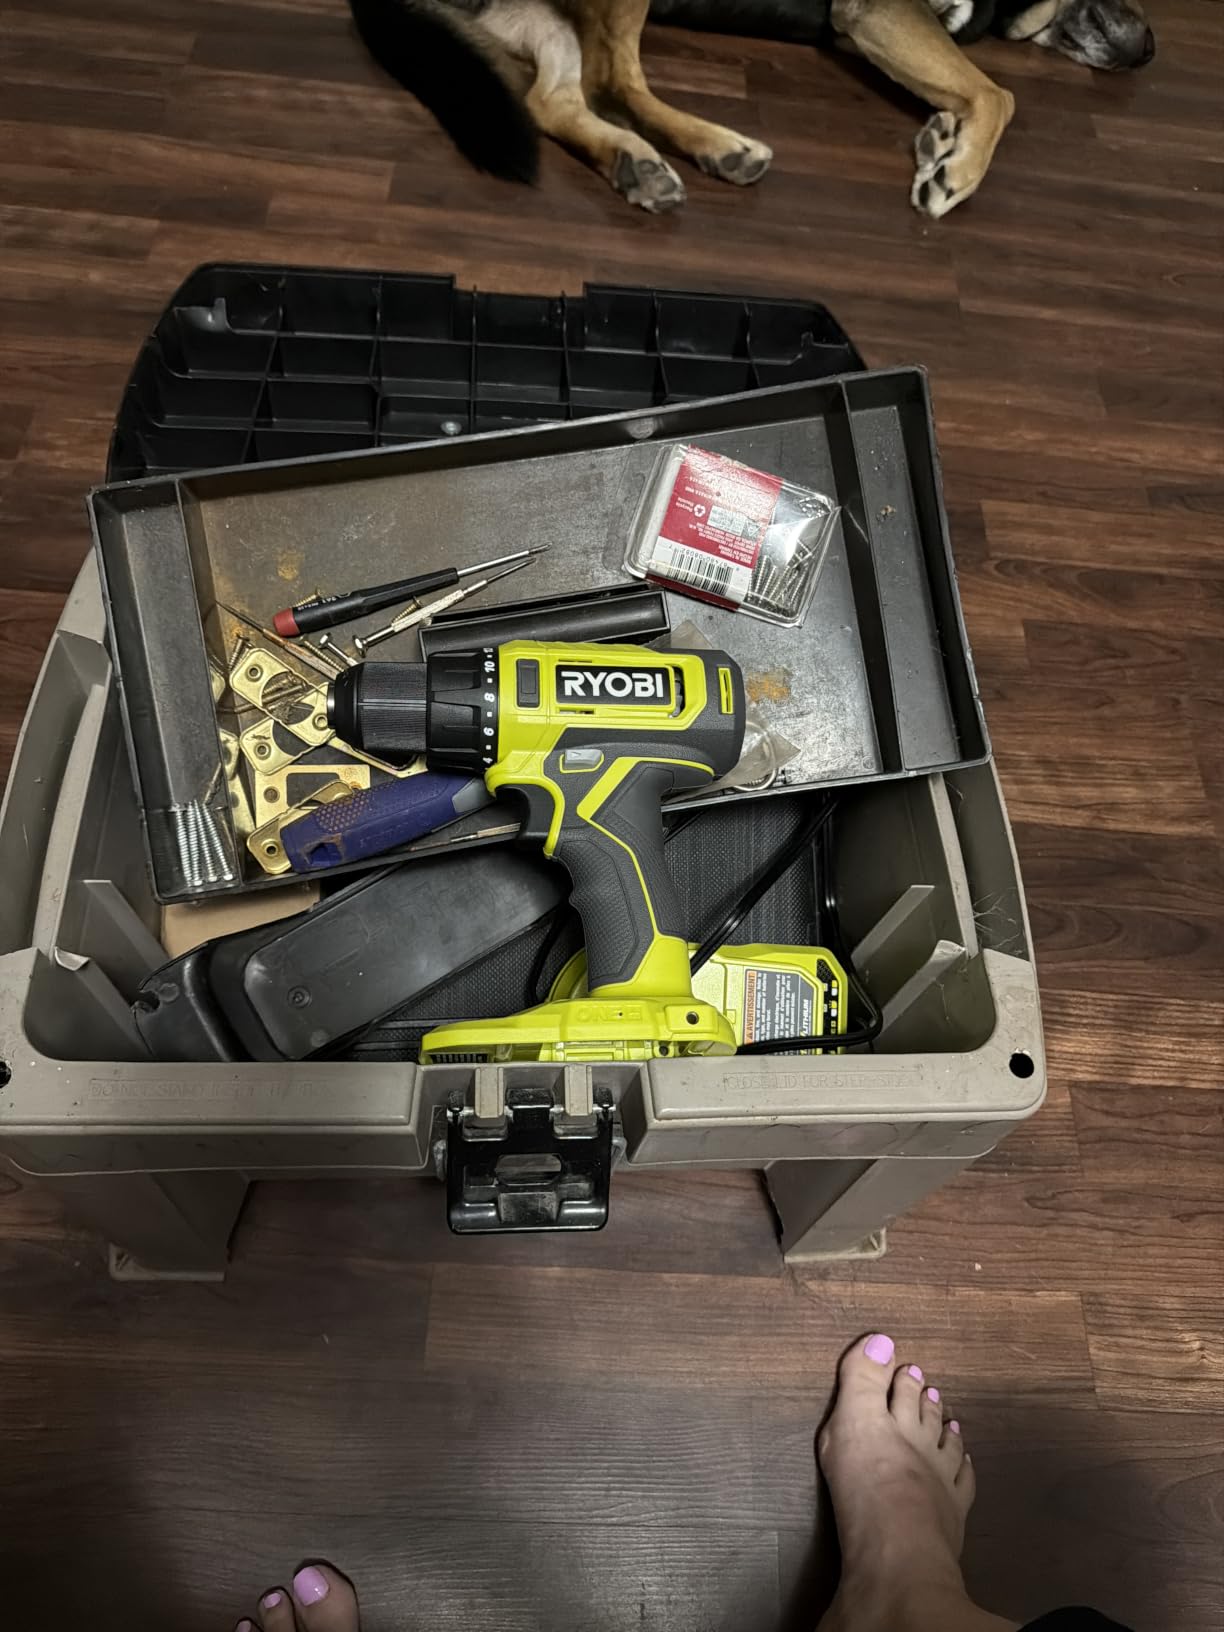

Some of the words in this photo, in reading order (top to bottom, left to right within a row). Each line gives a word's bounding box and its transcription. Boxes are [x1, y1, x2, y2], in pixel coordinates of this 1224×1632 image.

[484, 661, 495, 672] 10
[561, 671, 664, 698] RYOBI
[484, 692, 495, 702] 8
[483, 727, 495, 736] 6
[748, 974, 756, 1031] AVERTISSEMENT
[801, 999, 809, 1033] LITHIUM
[774, 1075, 798, 1089] LID
